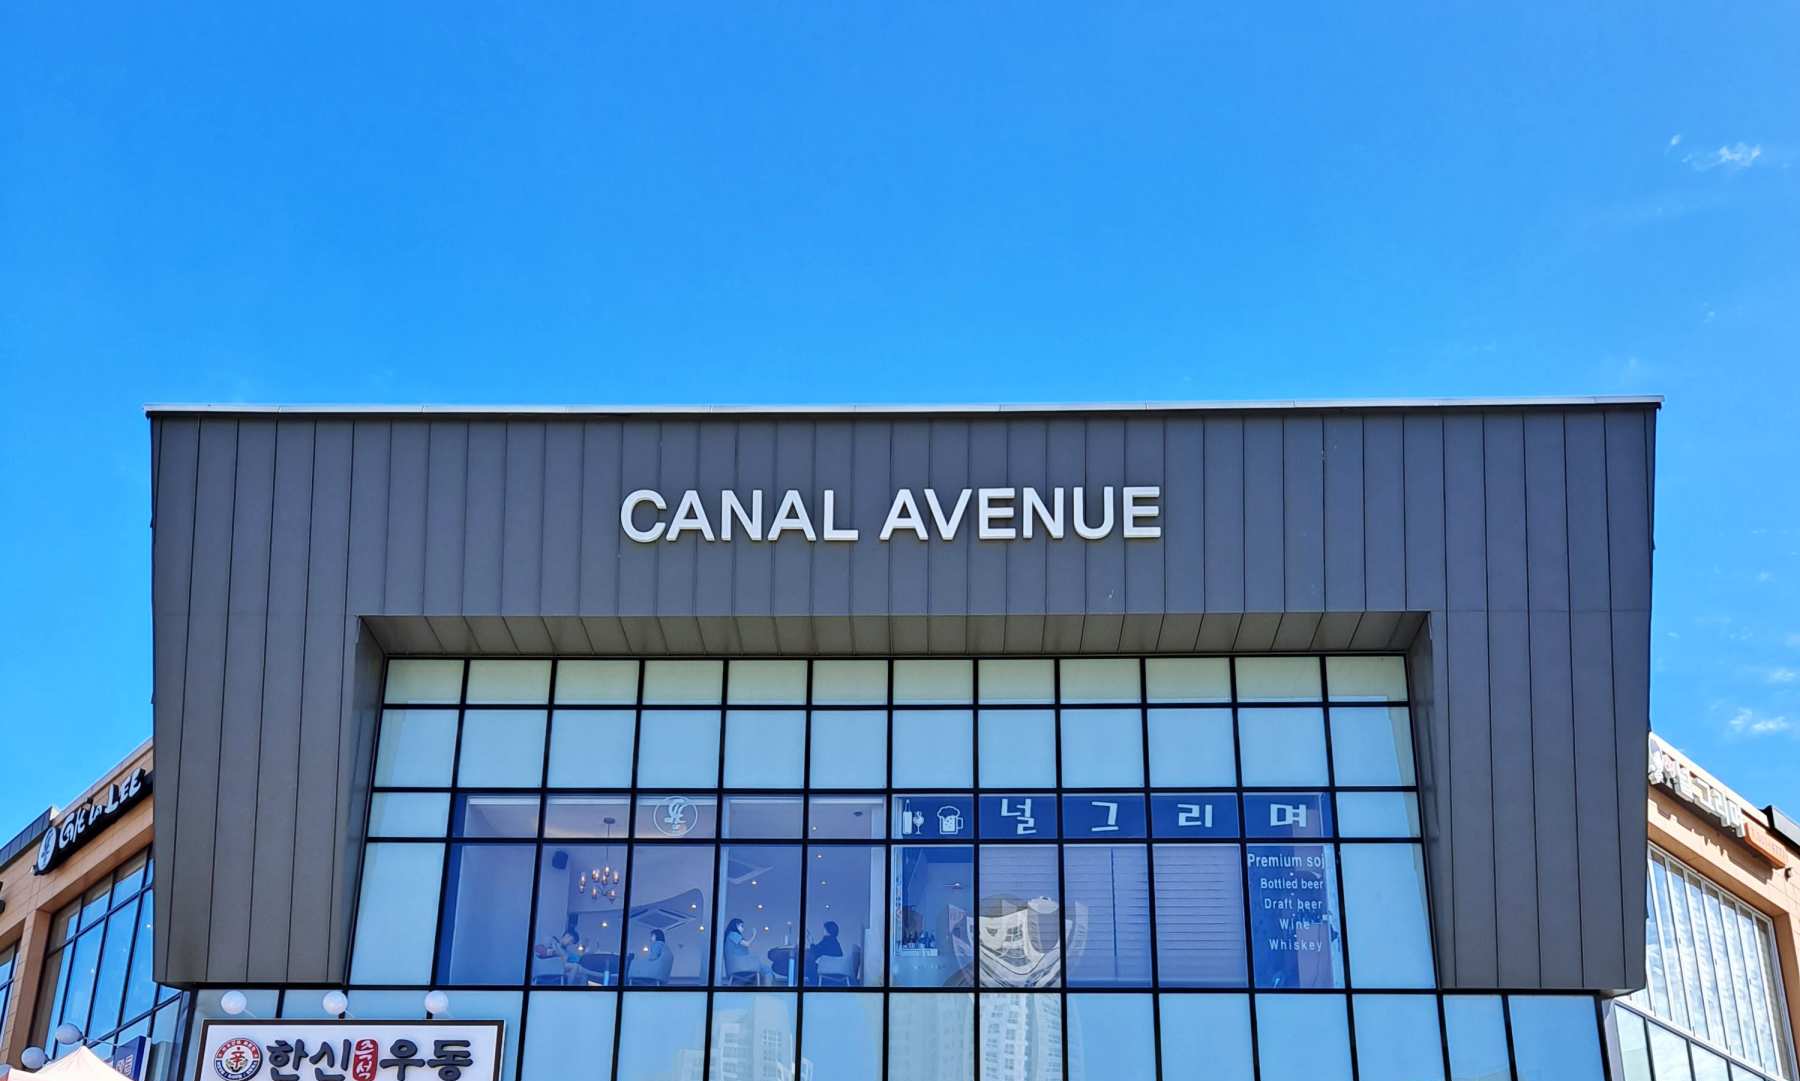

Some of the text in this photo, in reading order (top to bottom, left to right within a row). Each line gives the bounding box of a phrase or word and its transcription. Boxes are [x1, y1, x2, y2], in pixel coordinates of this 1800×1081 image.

[620, 486, 1161, 542] CANAL AVENUE
[1247, 853, 1302, 868] Premium
[1260, 877, 1324, 889] Bottled beer
[1264, 898, 1323, 910] Draft beer
[1279, 918, 1311, 930] Wine
[1269, 938, 1323, 952] Whiskey
